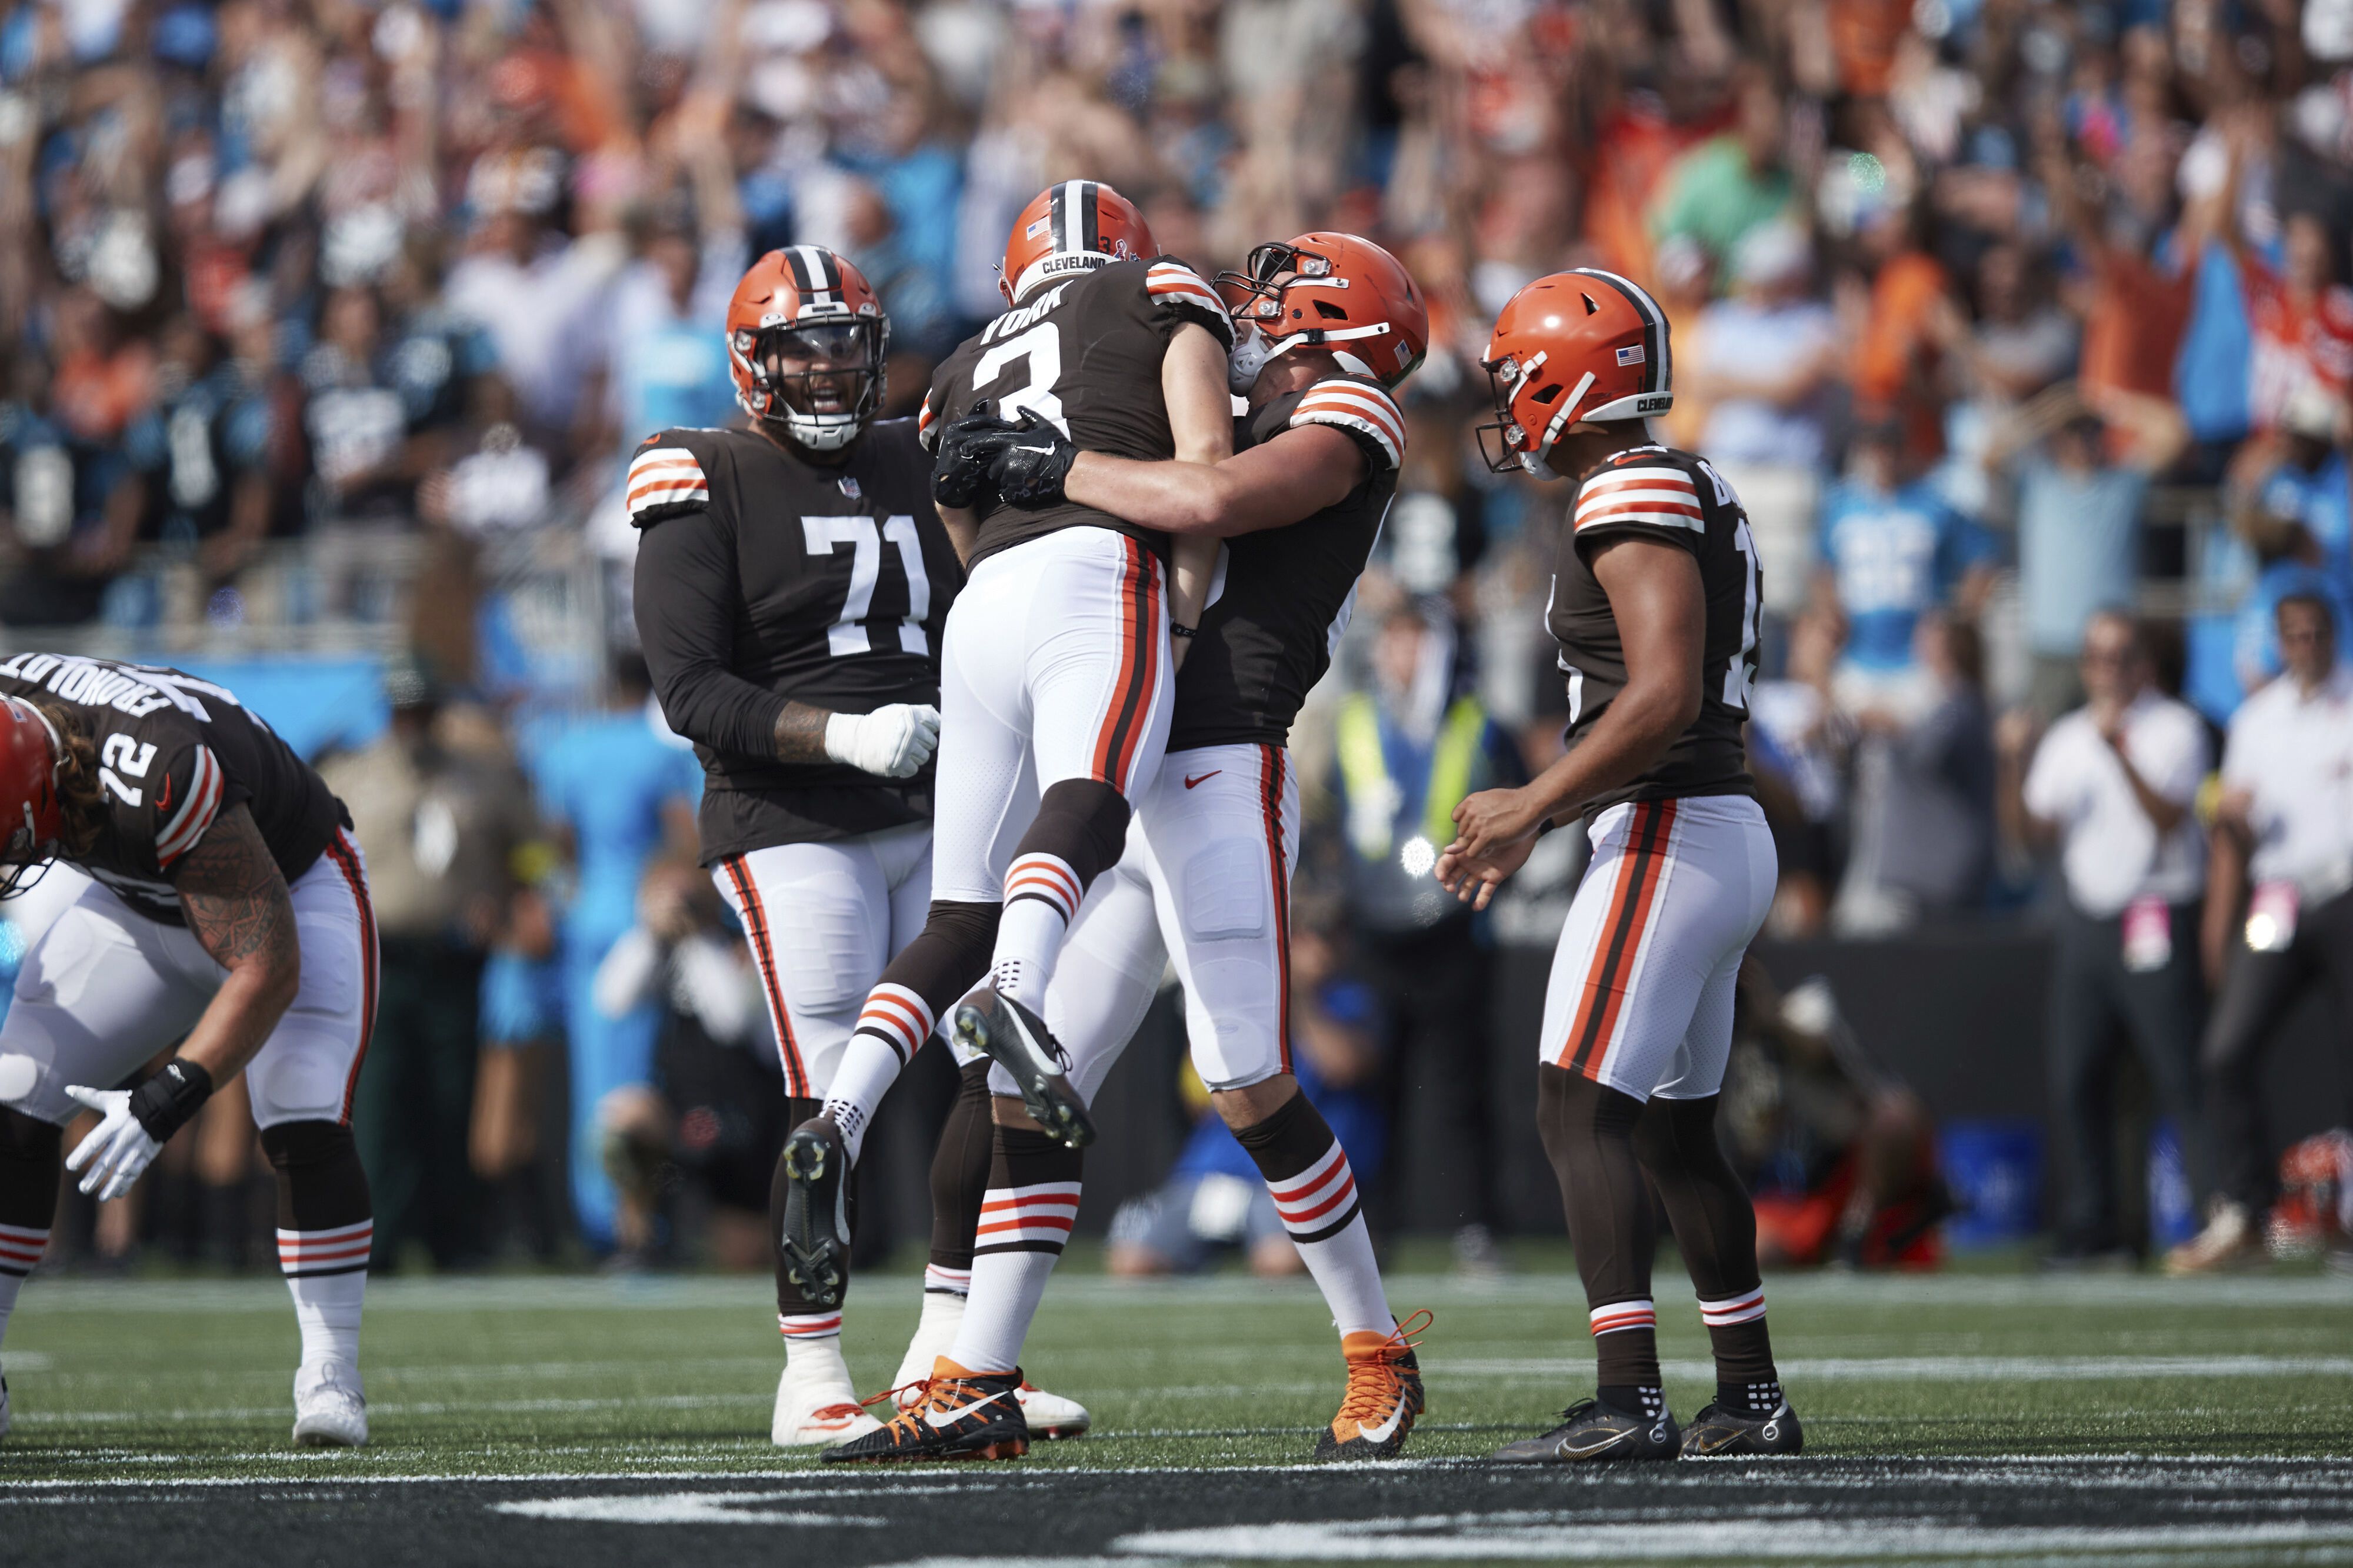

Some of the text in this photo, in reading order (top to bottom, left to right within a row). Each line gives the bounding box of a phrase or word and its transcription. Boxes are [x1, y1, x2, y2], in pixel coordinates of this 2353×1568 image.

[1042, 256, 1106, 274] CLEVELAND
[979, 279, 1074, 345] YORK
[972, 321, 1072, 442] 3
[801, 515, 930, 657] 71
[0, 653, 172, 719] FROHOLDT
[98, 732, 158, 807] 72
